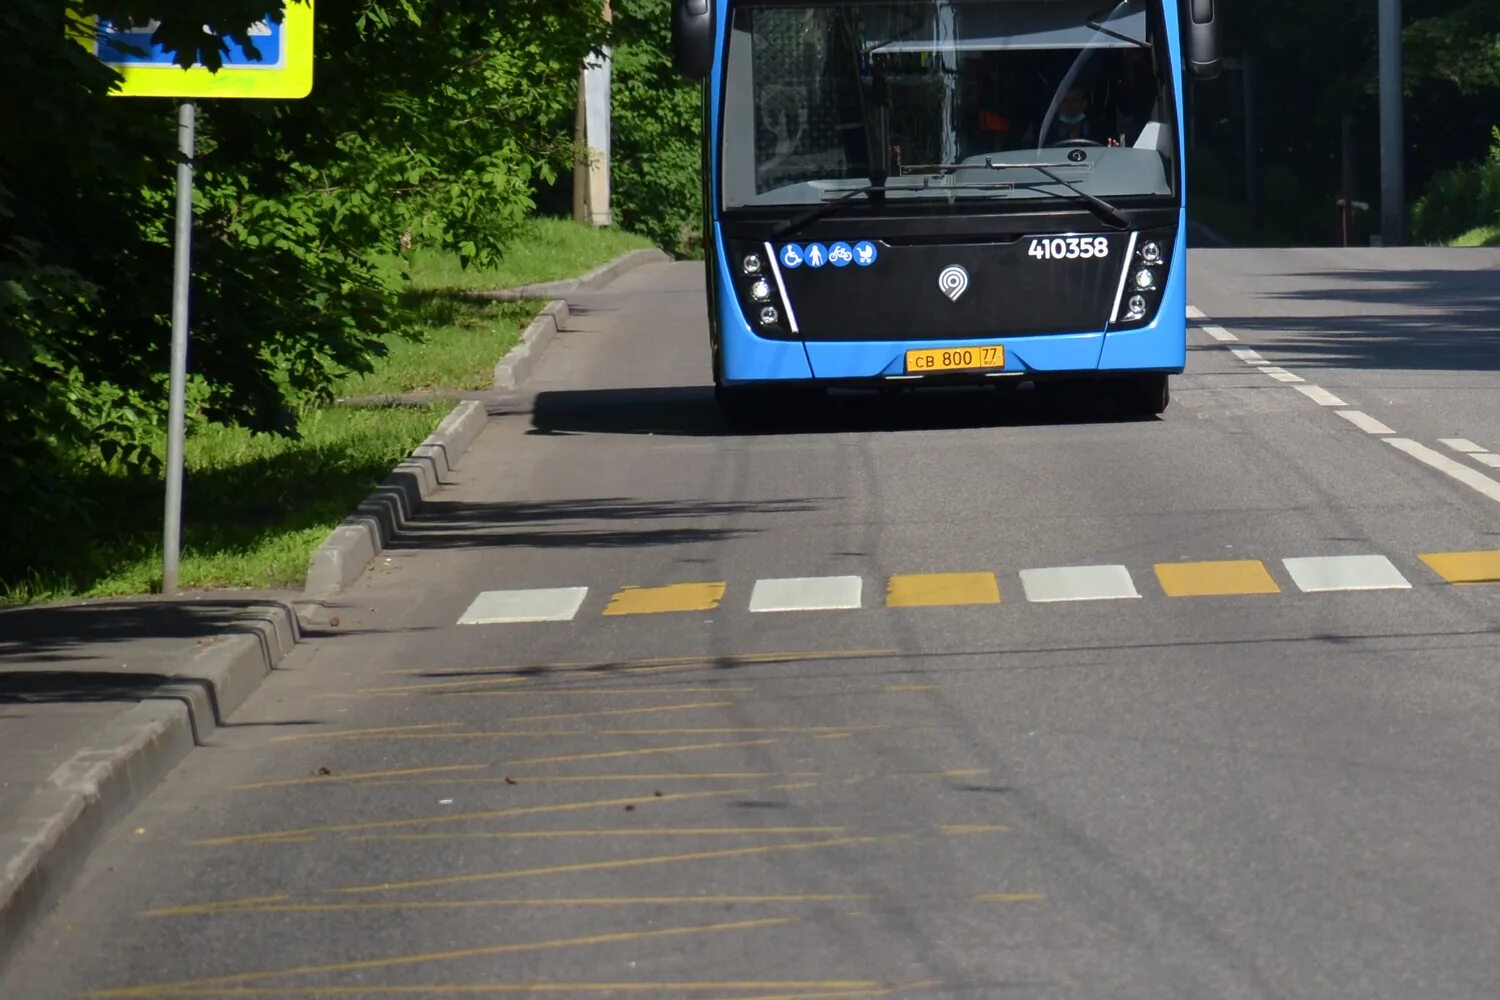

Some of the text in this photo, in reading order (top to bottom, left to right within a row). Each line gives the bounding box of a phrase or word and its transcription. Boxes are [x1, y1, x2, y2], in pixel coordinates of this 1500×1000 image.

[1028, 236, 1109, 260] 410358
[942, 350, 973, 367] 800
[982, 347, 998, 361] 77
